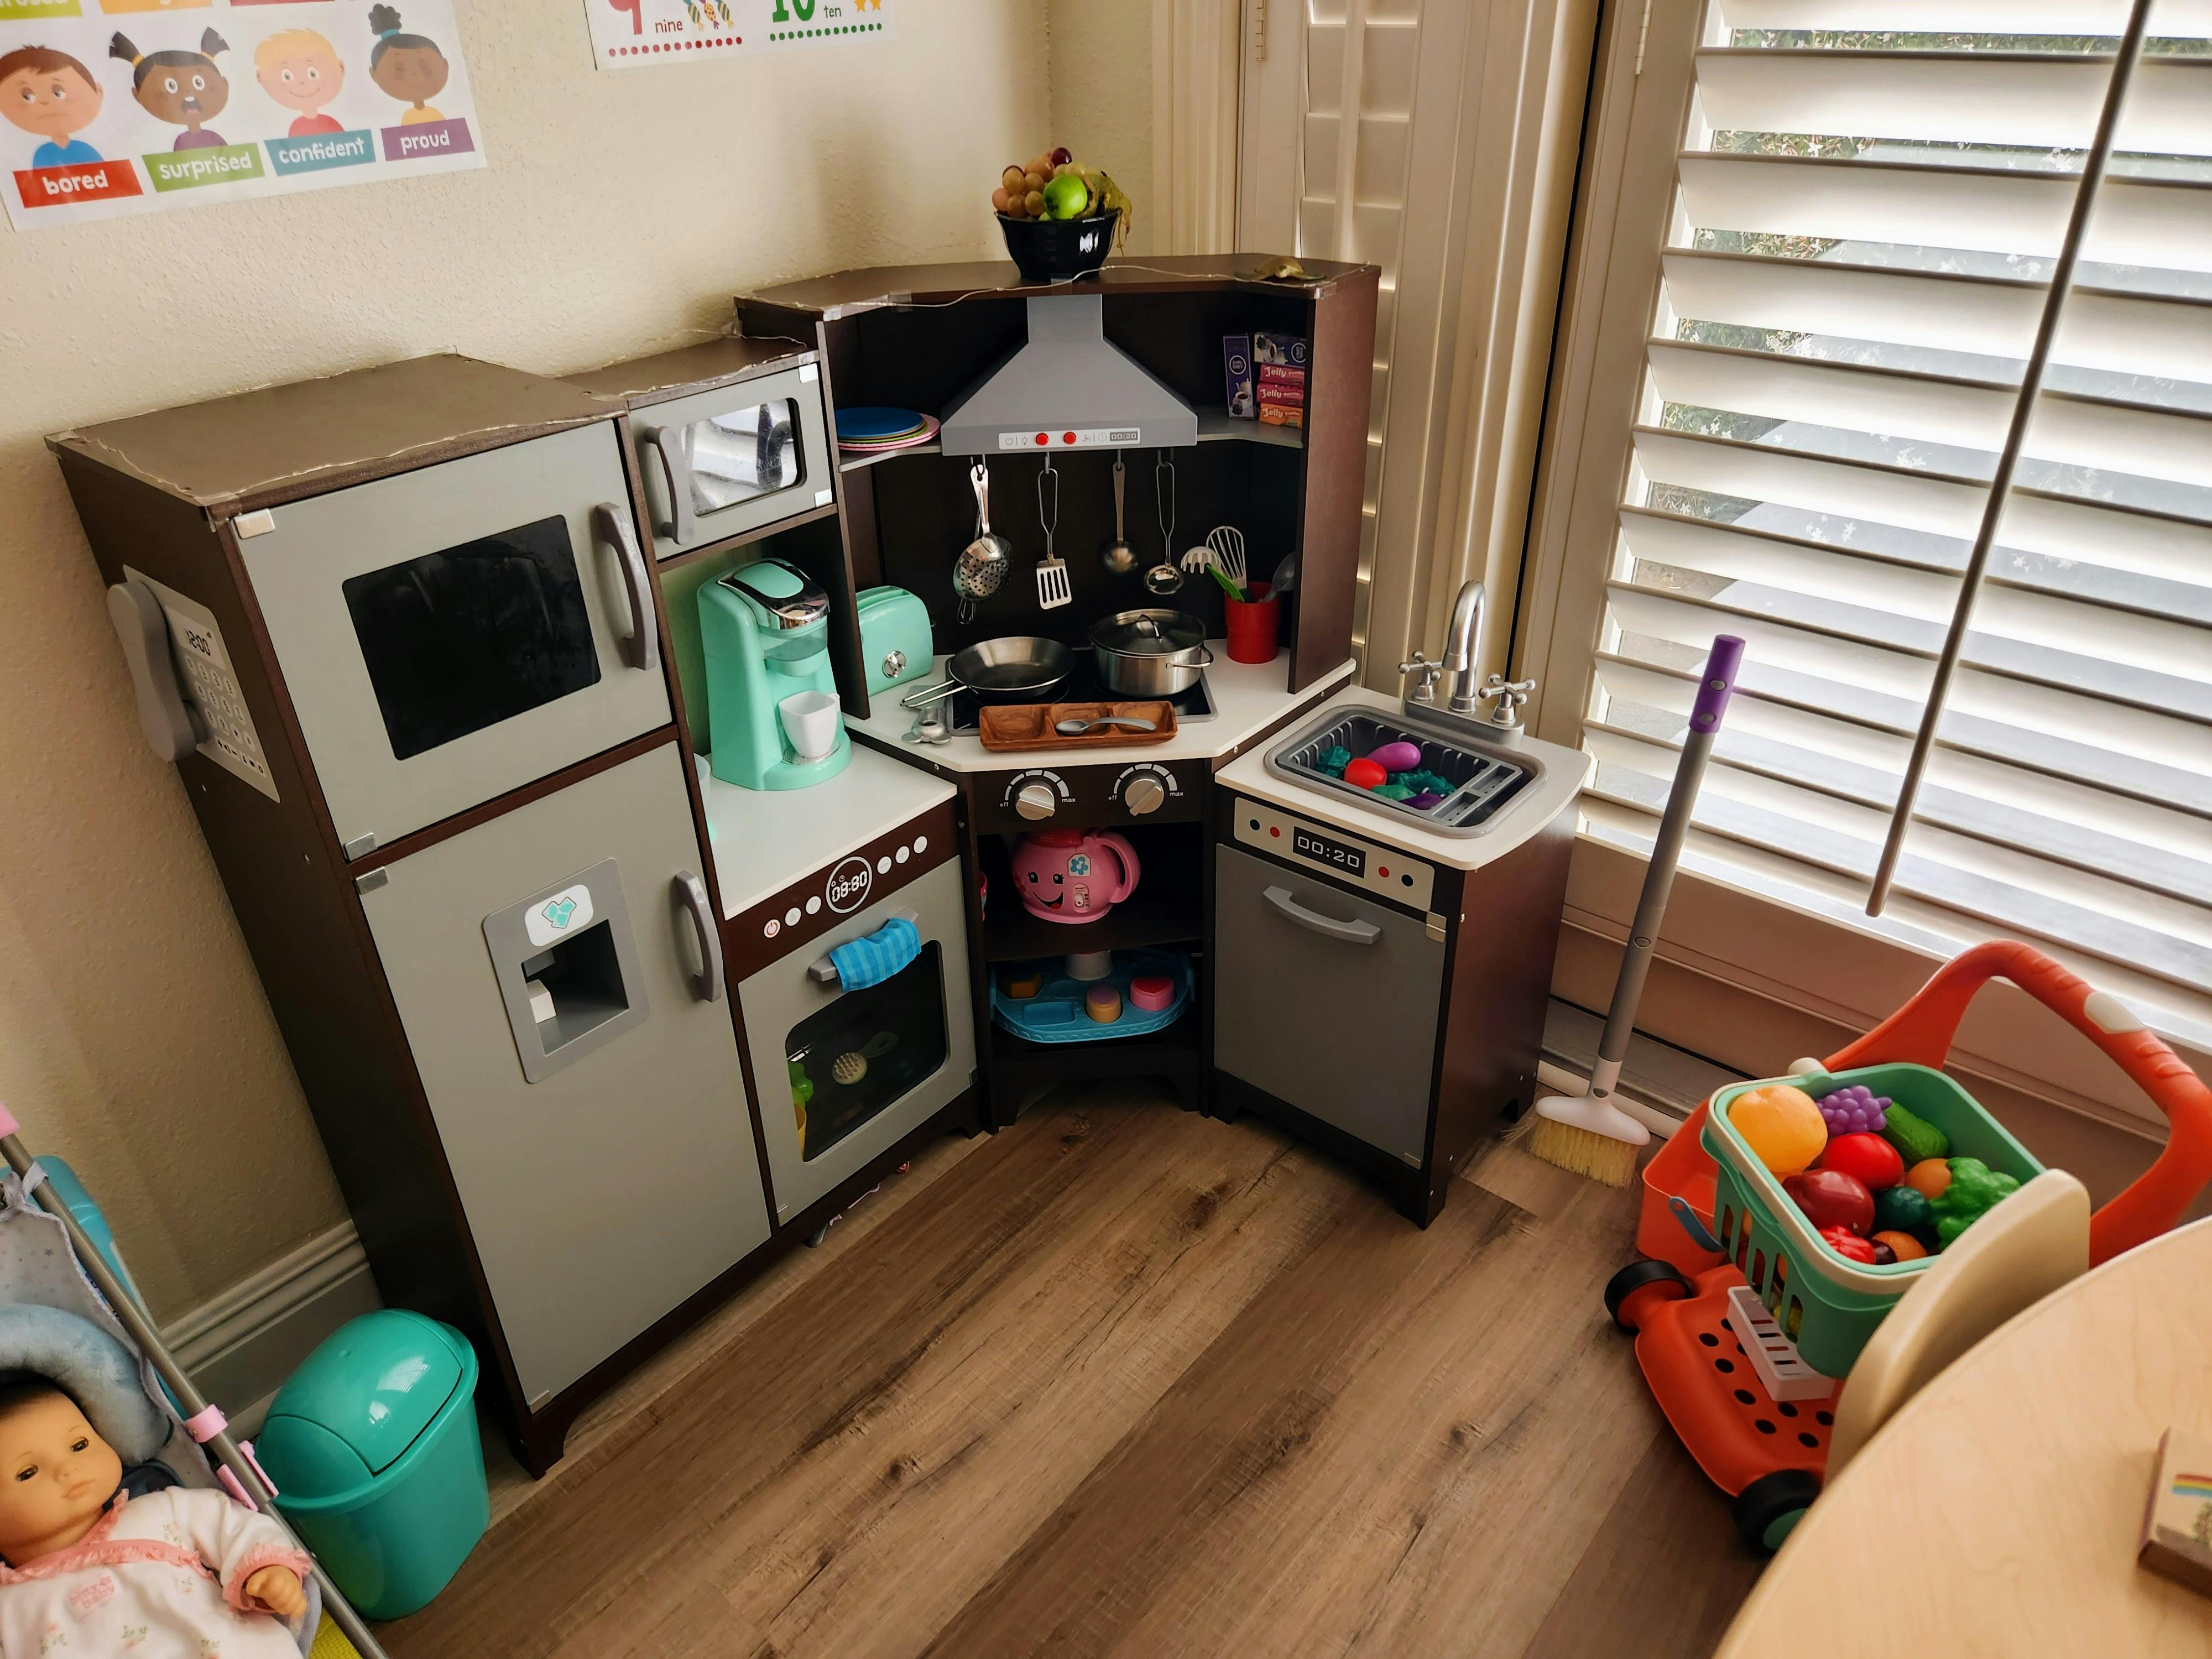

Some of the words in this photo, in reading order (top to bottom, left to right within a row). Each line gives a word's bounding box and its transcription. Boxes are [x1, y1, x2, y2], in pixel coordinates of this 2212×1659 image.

[824, 6, 842, 18] ten
[655, 19, 683, 33] nine
[278, 137, 365, 164] confident
[400, 130, 451, 155] proud
[159, 152, 253, 181] surprised
[42, 169, 109, 195] bored
[186, 629, 211, 656] 12:00
[1297, 836, 1360, 868] 00:20
[832, 870, 867, 902] 08:80
